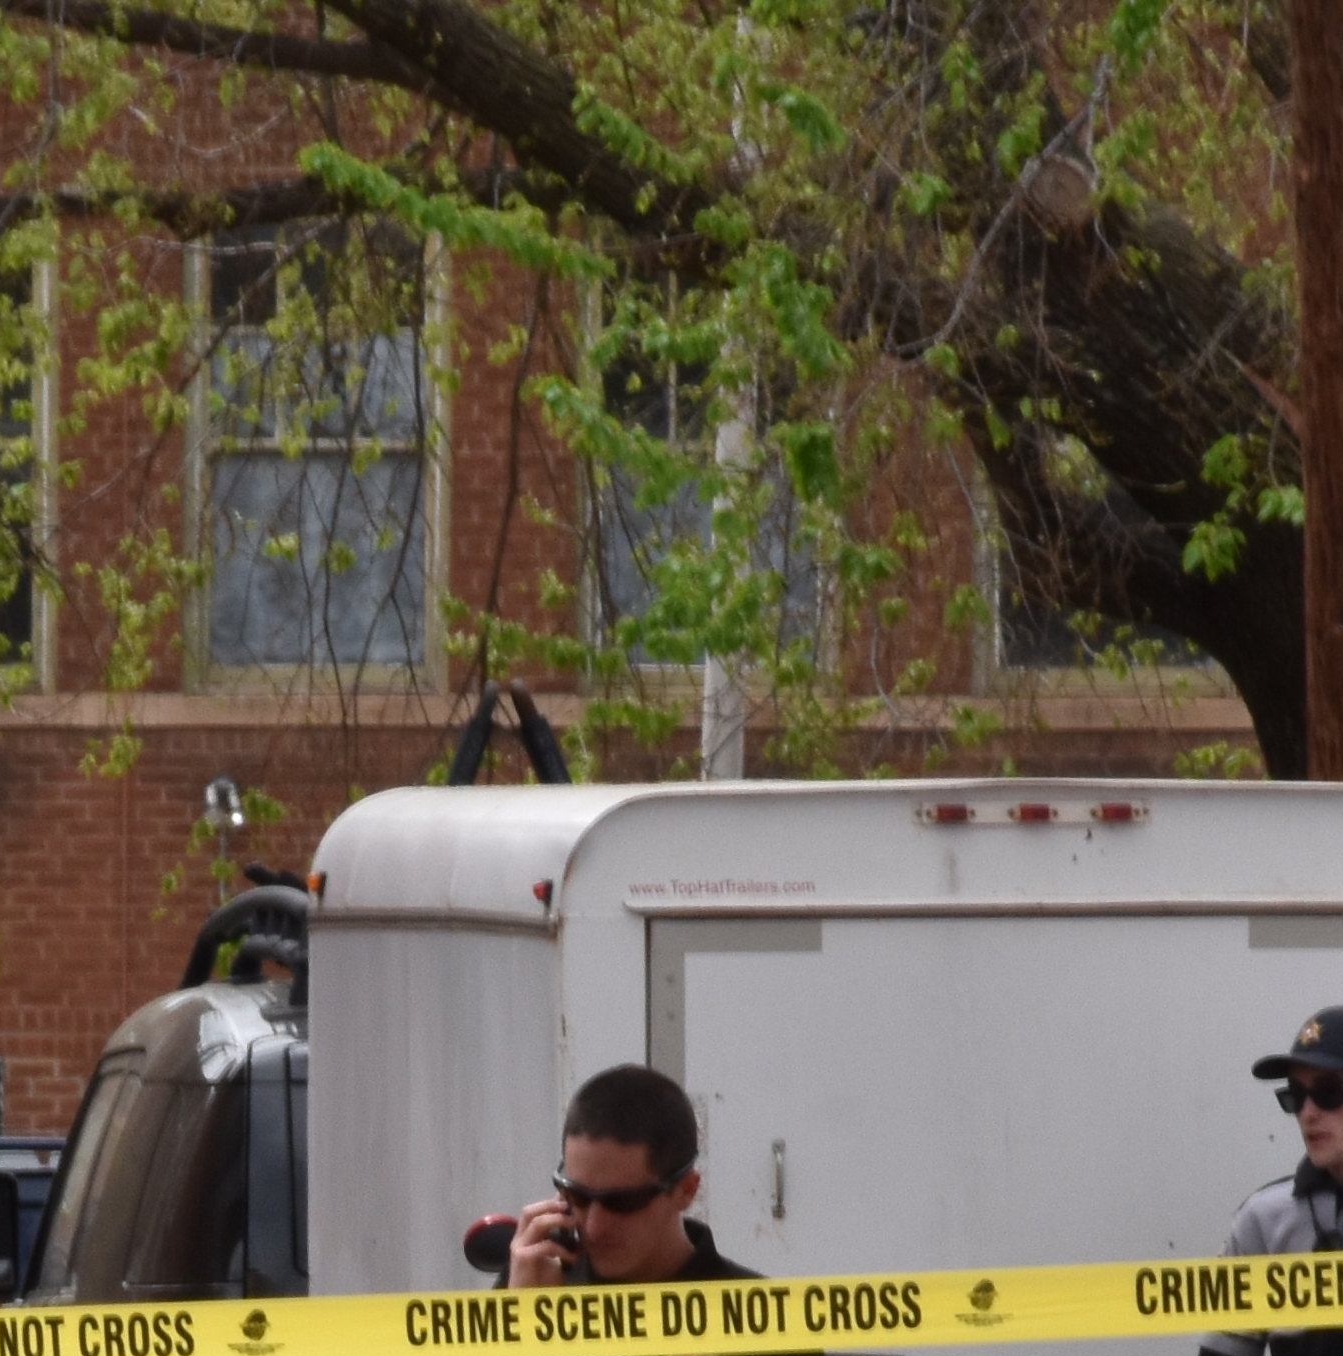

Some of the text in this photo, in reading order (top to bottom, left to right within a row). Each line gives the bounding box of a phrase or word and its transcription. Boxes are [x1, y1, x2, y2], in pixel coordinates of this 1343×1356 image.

[406, 1281, 922, 1346] CRIME SCENE DO NOT CROSS
[1135, 1263, 1252, 1315] CRIME
